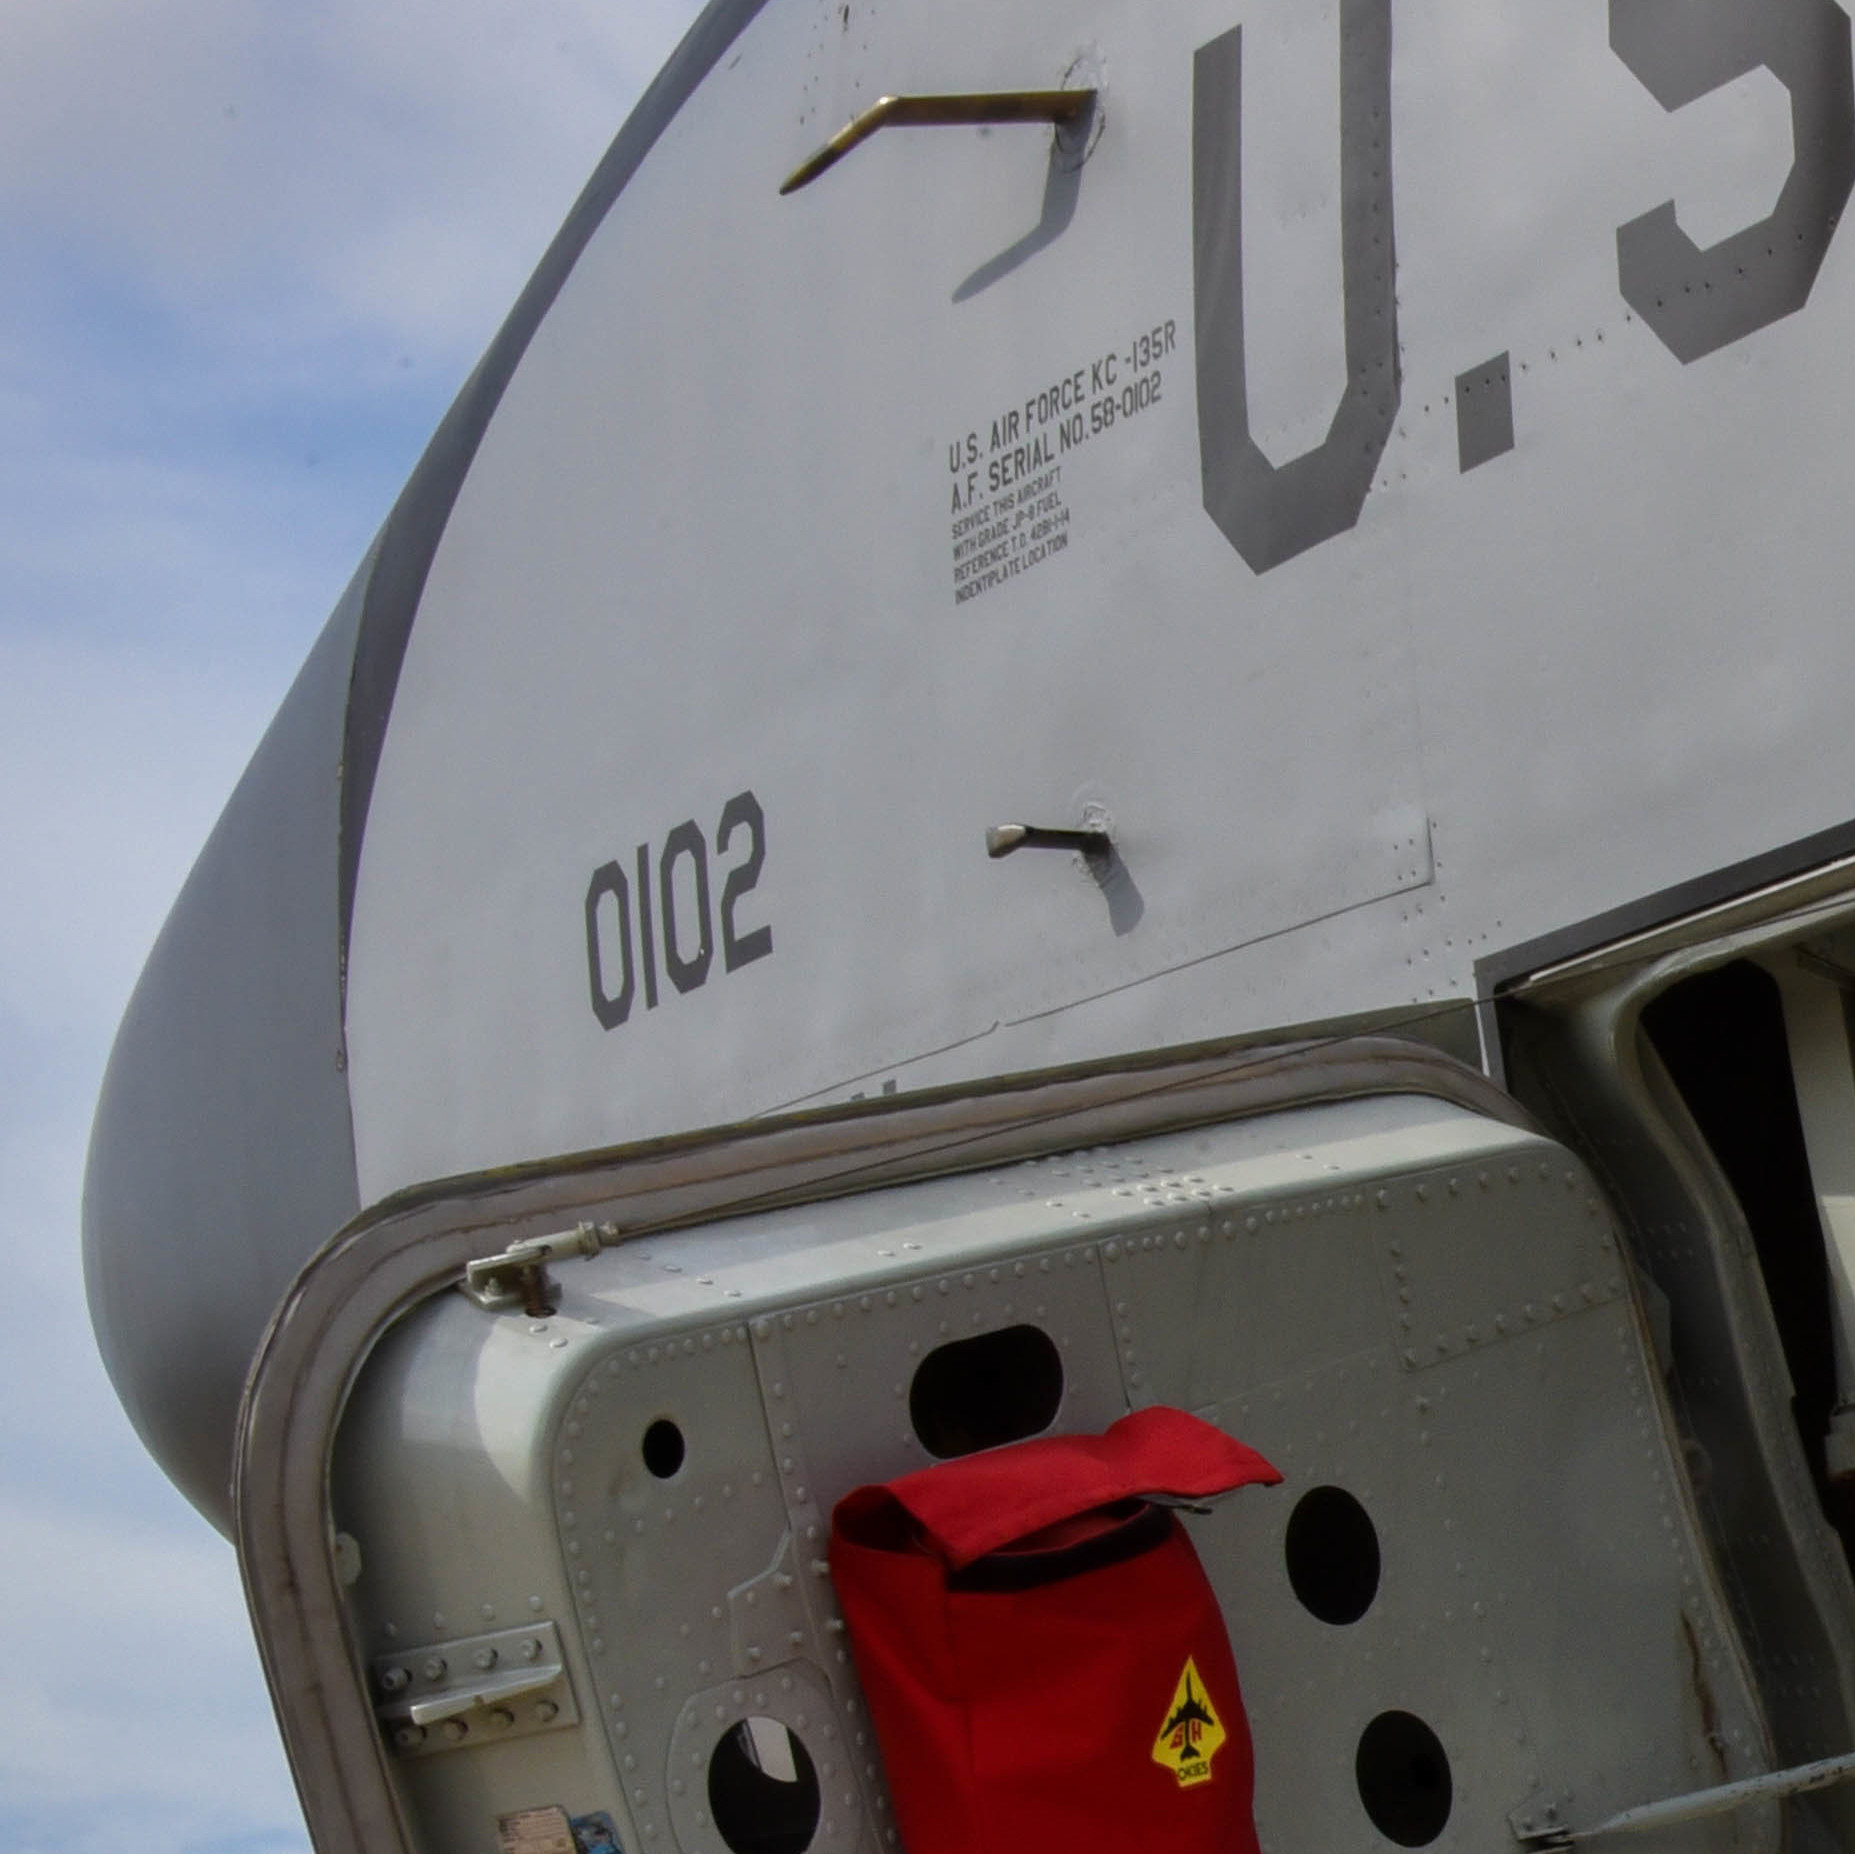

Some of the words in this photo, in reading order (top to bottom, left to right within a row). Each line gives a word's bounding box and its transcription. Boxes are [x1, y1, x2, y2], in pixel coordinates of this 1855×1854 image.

[949, 432, 983, 474] U.S.
[989, 410, 1020, 452] AIR
[1025, 370, 1085, 433] FORCE
[951, 471, 984, 515] A.F.
[989, 432, 1055, 493] SERIAL
[952, 505, 990, 539] SERVICE
[993, 493, 1015, 517] THIS
[1018, 466, 1062, 503] AIRCRAFT
[953, 537, 977, 561] WITH
[978, 517, 1009, 548] GRADE
[1036, 490, 1062, 516] FUEL
[953, 539, 1009, 582] REFERENCE
[1022, 531, 1068, 570] LOCATION
[585, 789, 773, 1032] 0102
